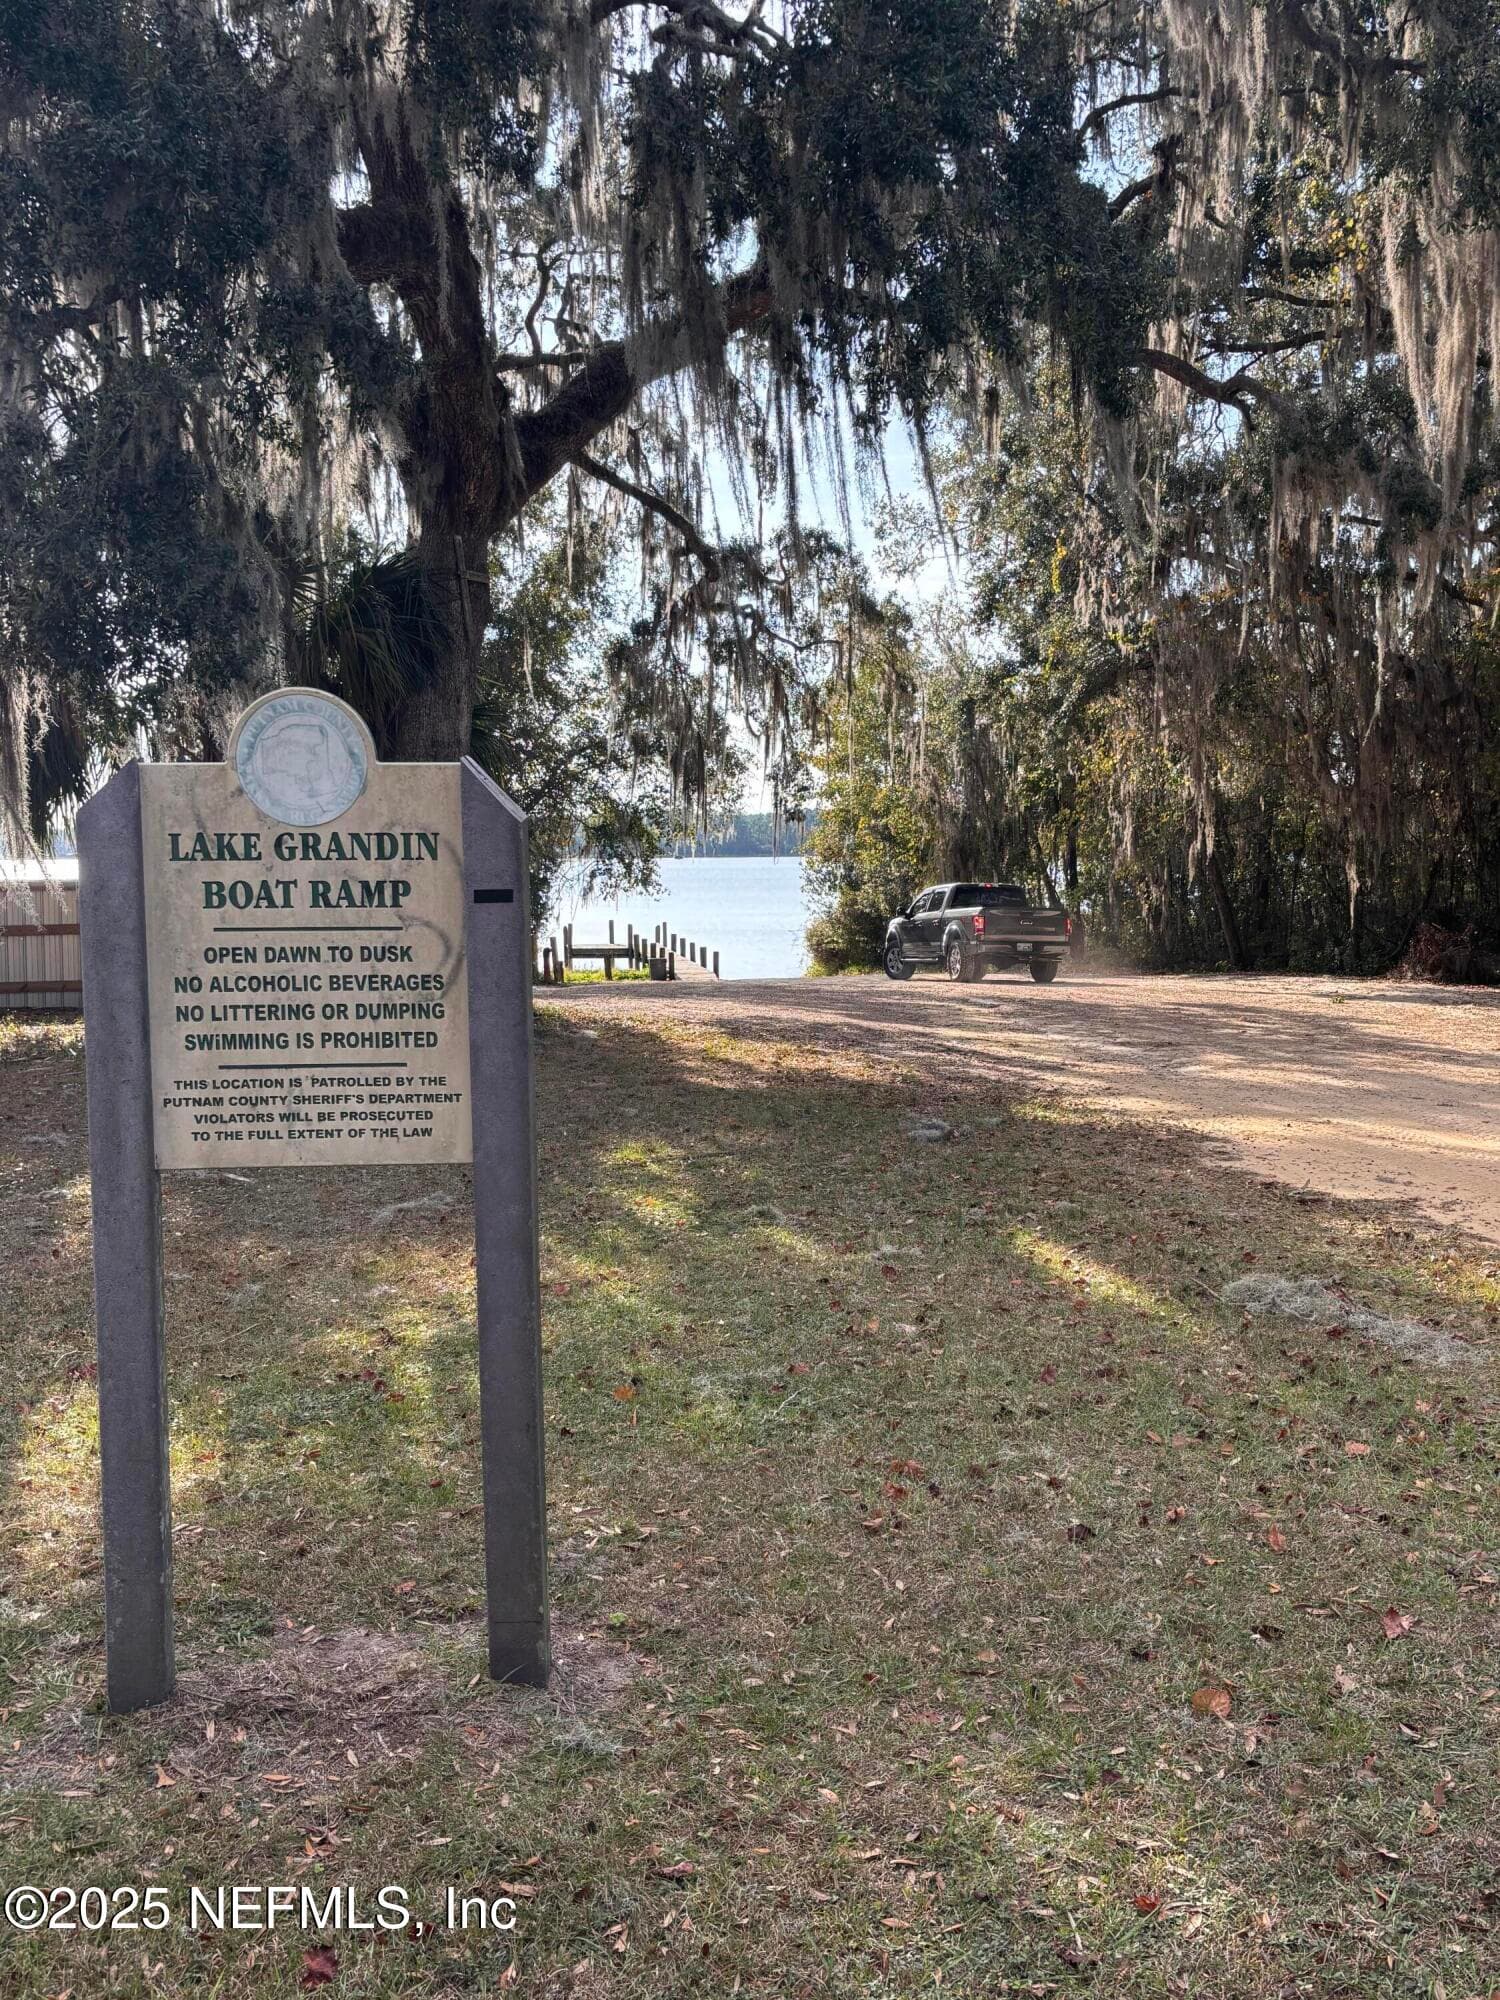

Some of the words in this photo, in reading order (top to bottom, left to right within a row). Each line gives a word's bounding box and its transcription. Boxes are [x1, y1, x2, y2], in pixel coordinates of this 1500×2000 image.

[168, 833, 262, 861] LAKE
[274, 832, 440, 860] GRANDIN
[202, 880, 298, 909] BOAT
[309, 880, 411, 908] RAMP
[204, 947, 257, 964] OPEN
[264, 946, 321, 963] DAWN
[328, 946, 353, 963] TO
[360, 946, 412, 963] DUSK
[174, 976, 203, 993] NO
[209, 975, 322, 993] ALCOHOLIC
[329, 974, 444, 992] BEVERAGES
[176, 1005, 204, 1022] NO
[211, 1004, 315, 1021] LITTERING
[322, 1004, 349, 1020] OR
[356, 1002, 445, 1020] DUMPING
[296, 1032, 314, 1049] IS
[321, 1031, 438, 1048] PROHIBITED
[174, 1080, 208, 1090] THIS
[212, 1078, 284, 1090] LOCATION
[289, 1078, 302, 1088] IS
[311, 1077, 391, 1088] PATROLLED
[396, 1076, 413, 1087] BY
[419, 1076, 447, 1086] THE
[163, 1096, 224, 1108] PUTNAM
[228, 1096, 288, 1106] COUNTY
[293, 1094, 365, 1105] SHERIFF'S
[369, 1093, 462, 1104] DEPARTMENT
[194, 1112, 275, 1124] VIOLATORS
[279, 1112, 313, 1123] WILL
[318, 1111, 336, 1121] BE
[340, 1110, 433, 1121] PROSECUTED
[191, 1131, 210, 1141] TO
[215, 1130, 243, 1141] THE
[248, 1130, 283, 1140] FULL
[288, 1128, 343, 1139] EXTENT
[348, 1128, 368, 1138] OF
[372, 1128, 398, 1138] THE
[403, 1127, 433, 1137] LAW
